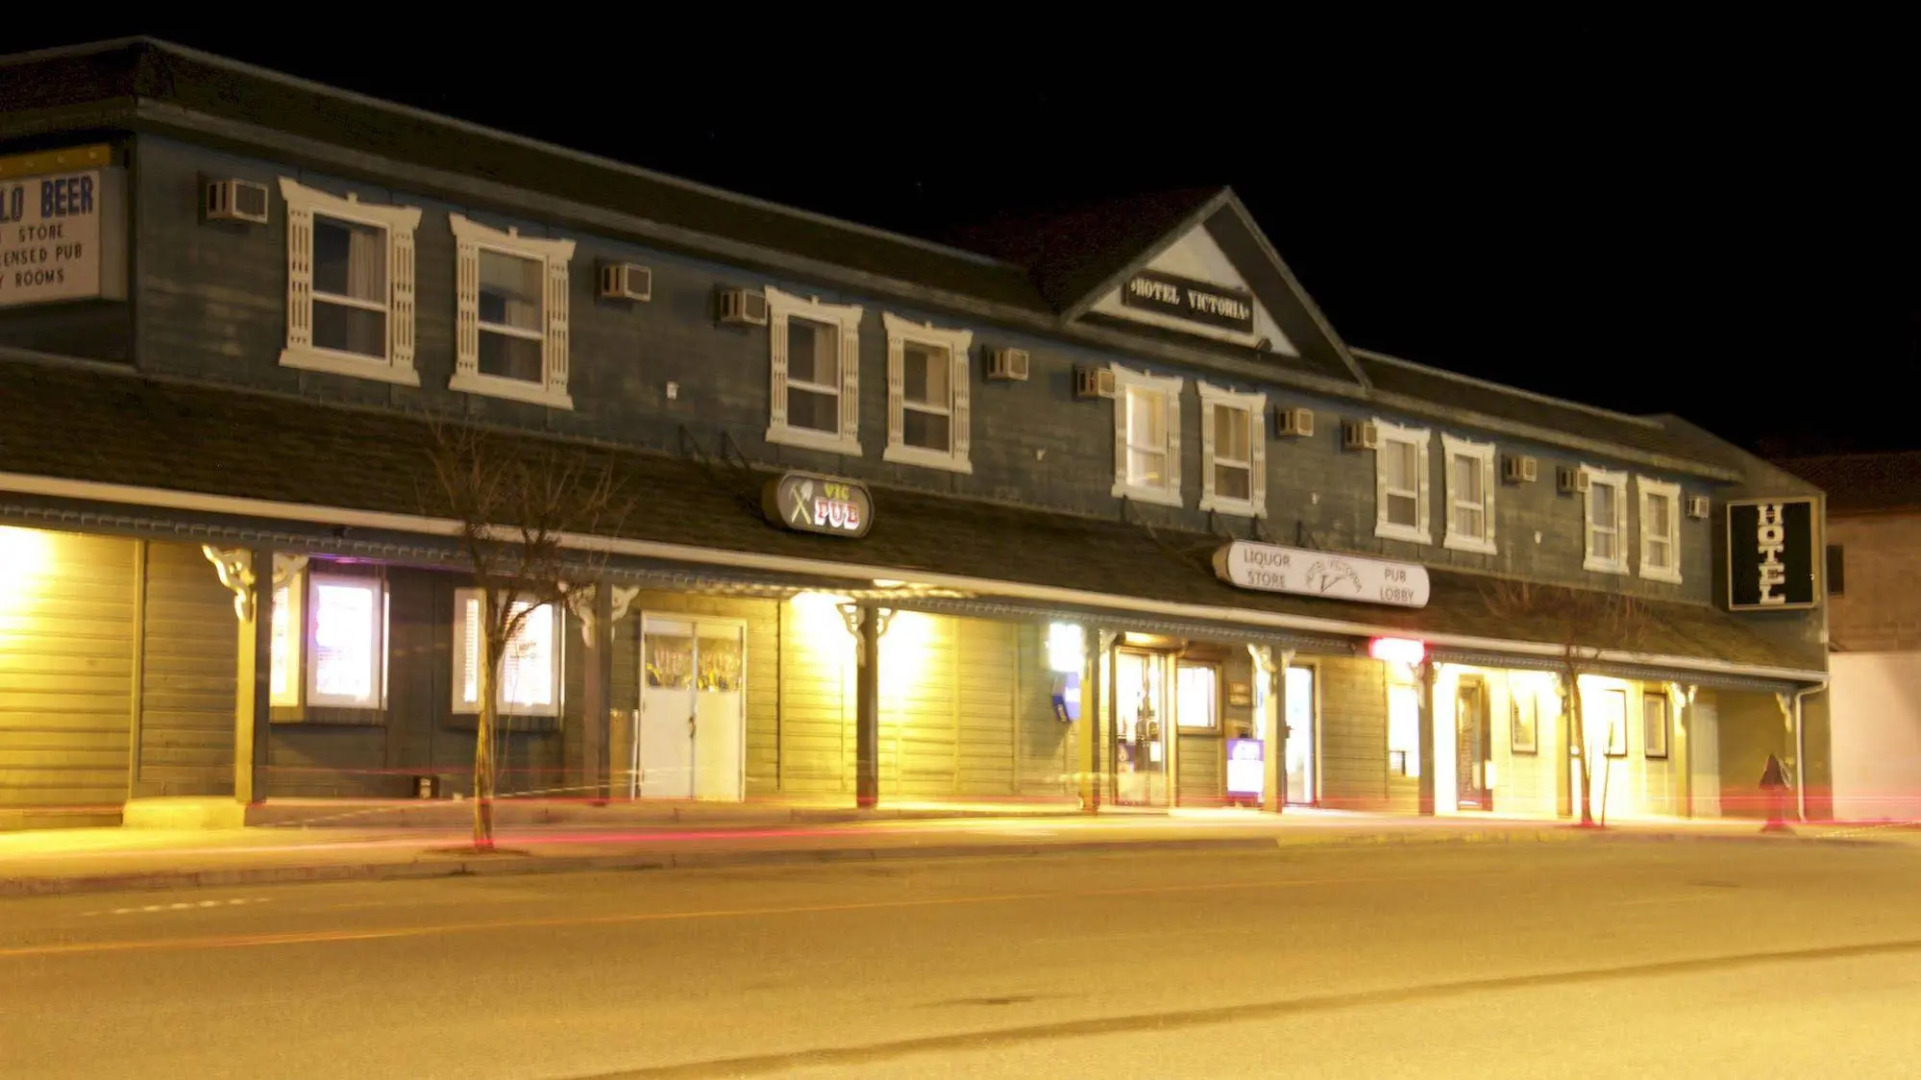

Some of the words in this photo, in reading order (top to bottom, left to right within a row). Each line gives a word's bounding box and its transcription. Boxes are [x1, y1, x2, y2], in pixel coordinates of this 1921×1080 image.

[41, 175, 94, 218] BEER
[19, 223, 64, 243] STORE
[0, 248, 47, 268] ENSED
[56, 243, 83, 262] PUB
[16, 269, 64, 288] ROOMS
[814, 497, 860, 530] PUB
[1243, 548, 1291, 568] LIQUOR
[1757, 504, 1786, 605] HOTEL
[1247, 571, 1286, 589] STORE
[1384, 567, 1407, 583] PUB
[1379, 588, 1414, 603] LOBBY
